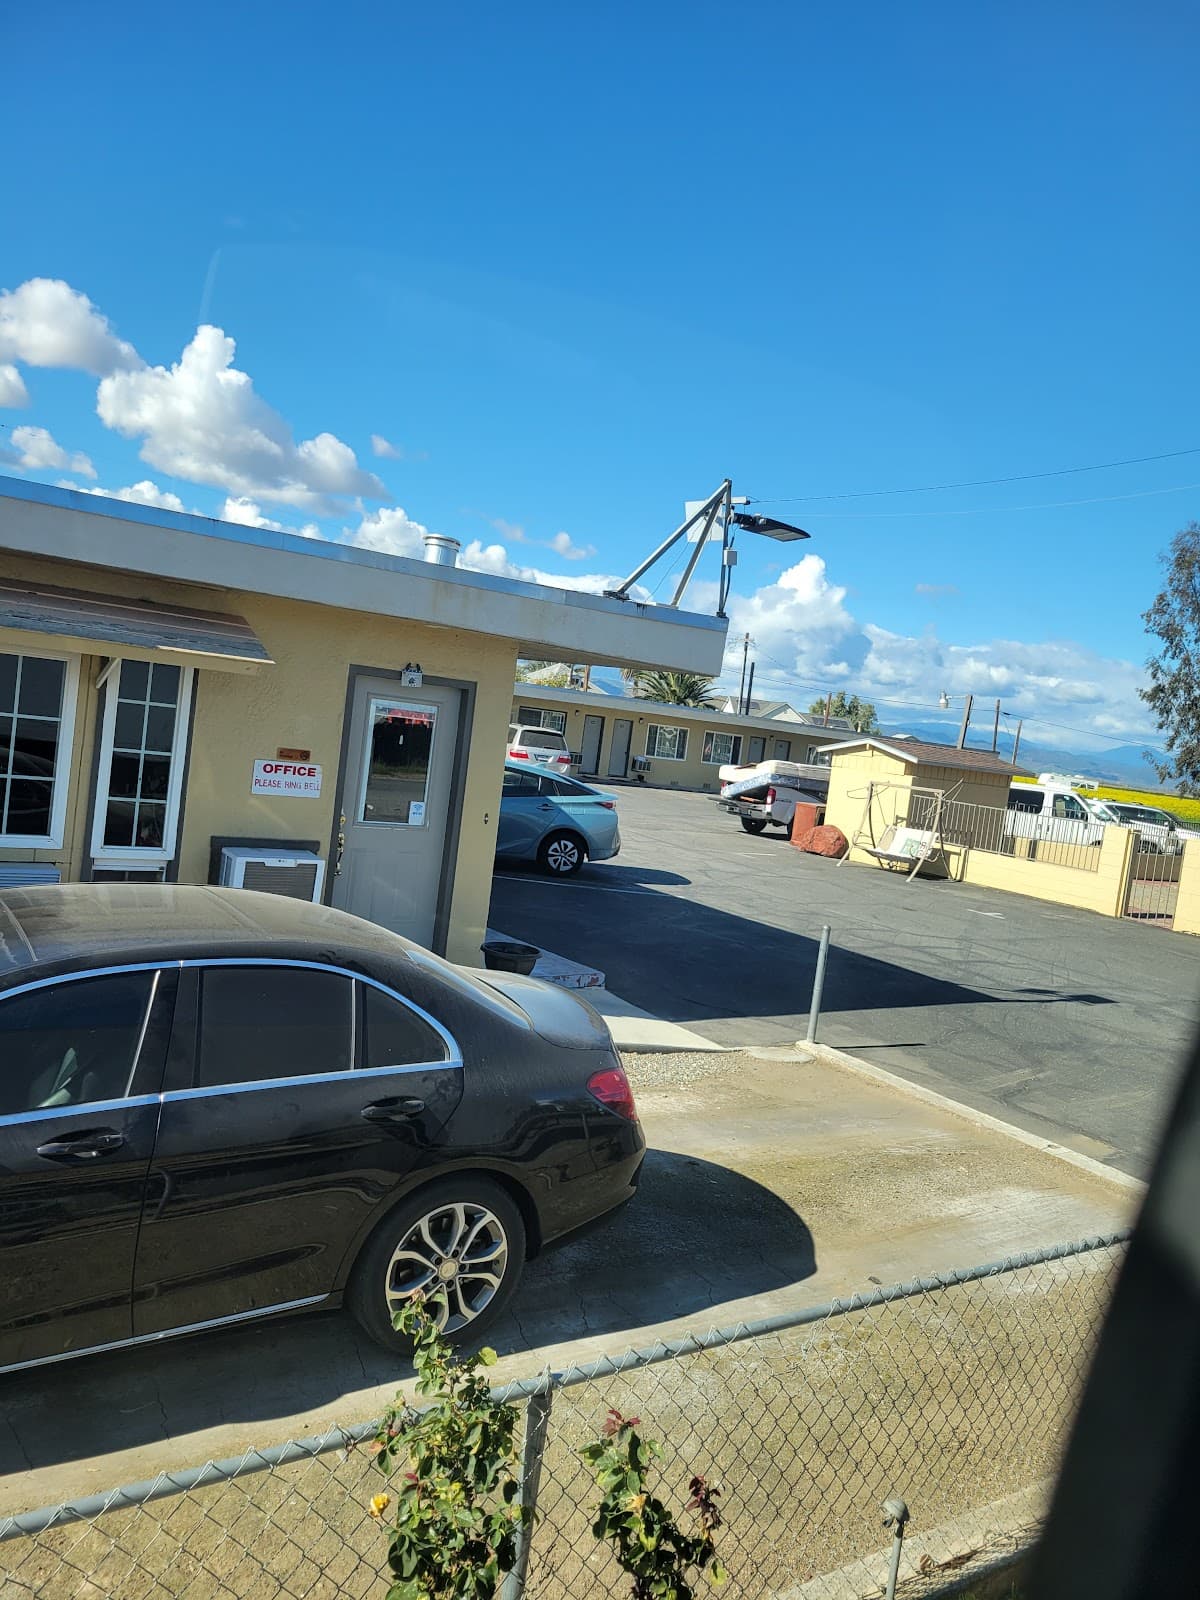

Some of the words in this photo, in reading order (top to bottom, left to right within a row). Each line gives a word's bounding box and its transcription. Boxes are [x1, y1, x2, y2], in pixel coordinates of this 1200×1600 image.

[262, 763, 317, 777] OFFICE
[254, 778, 281, 788] PLEASE
[284, 780, 302, 790] RING
[304, 781, 321, 791] BELL
